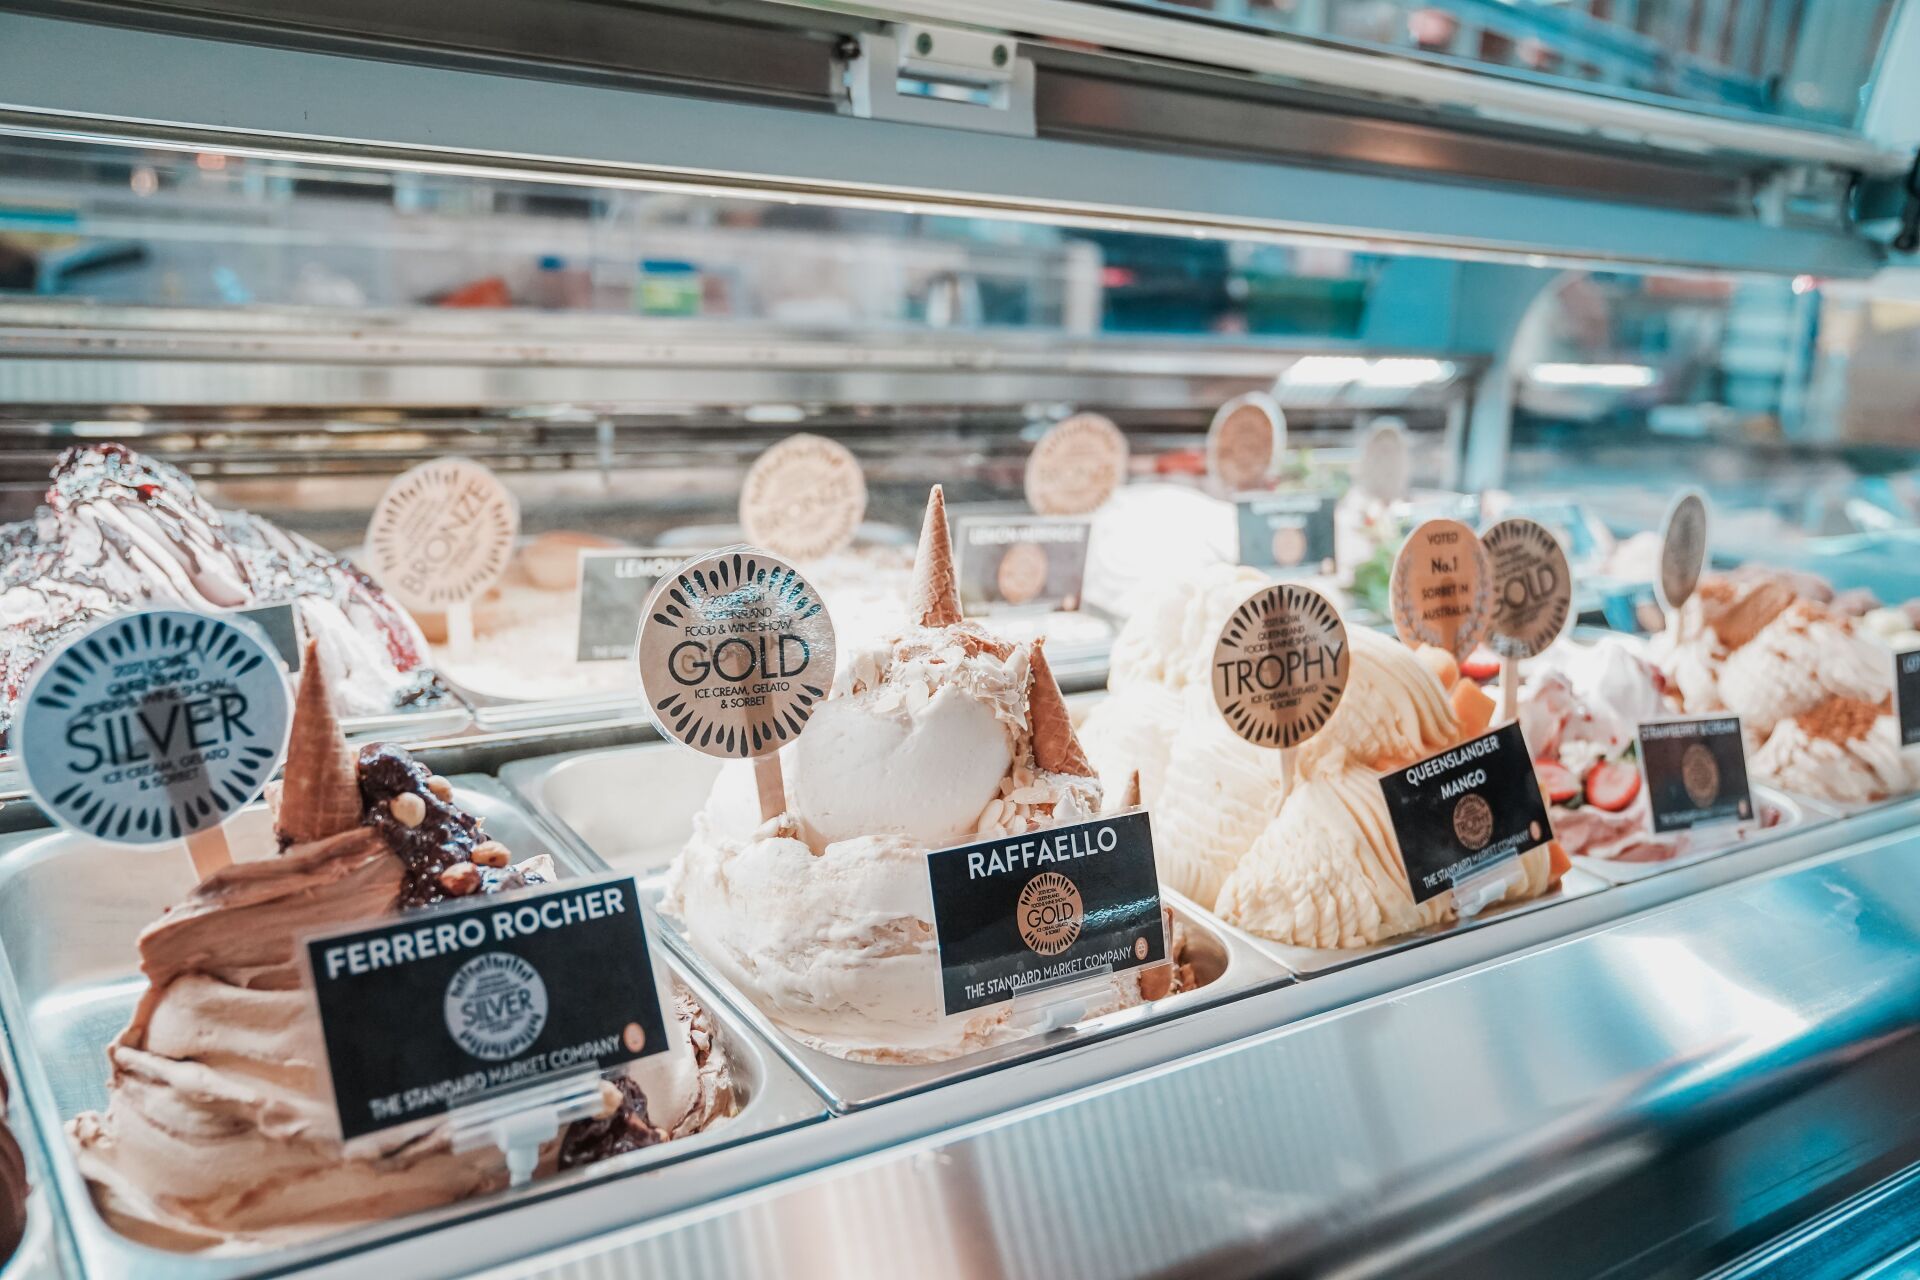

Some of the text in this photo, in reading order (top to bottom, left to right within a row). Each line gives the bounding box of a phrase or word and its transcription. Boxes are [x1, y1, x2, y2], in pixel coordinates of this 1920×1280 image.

[400, 478, 491, 595] BRONZE
[1427, 532, 1458, 545] VOTED
[685, 618, 792, 636] FOOD & WINE SHOW
[1422, 605, 1472, 621] AUSTRALIA
[668, 634, 810, 686] GOLD
[1217, 641, 1344, 697] TROPHY
[695, 688, 710, 699] ICE
[753, 681, 790, 693] GELATO
[720, 696, 766, 709] & SORBET
[65, 692, 255, 774] SILVER
[103, 770, 124, 785] ICE
[177, 748, 230, 769] GELATO
[152, 768, 201, 789] SORBET
[1406, 734, 1500, 787] QUEENSLANDER
[1440, 768, 1487, 800] MANGO
[967, 826, 1118, 880] RAFFAELLO
[1422, 874, 1438, 889] THE
[324, 886, 626, 981] FERRERO ROCHER
[1027, 902, 1074, 928] GOLD
[964, 945, 1133, 1000] THE STANDARD MARKET COMPANY
[461, 988, 534, 1027] SILVER
[368, 1034, 621, 1121] THE STANDARD MARKET COMPANY
